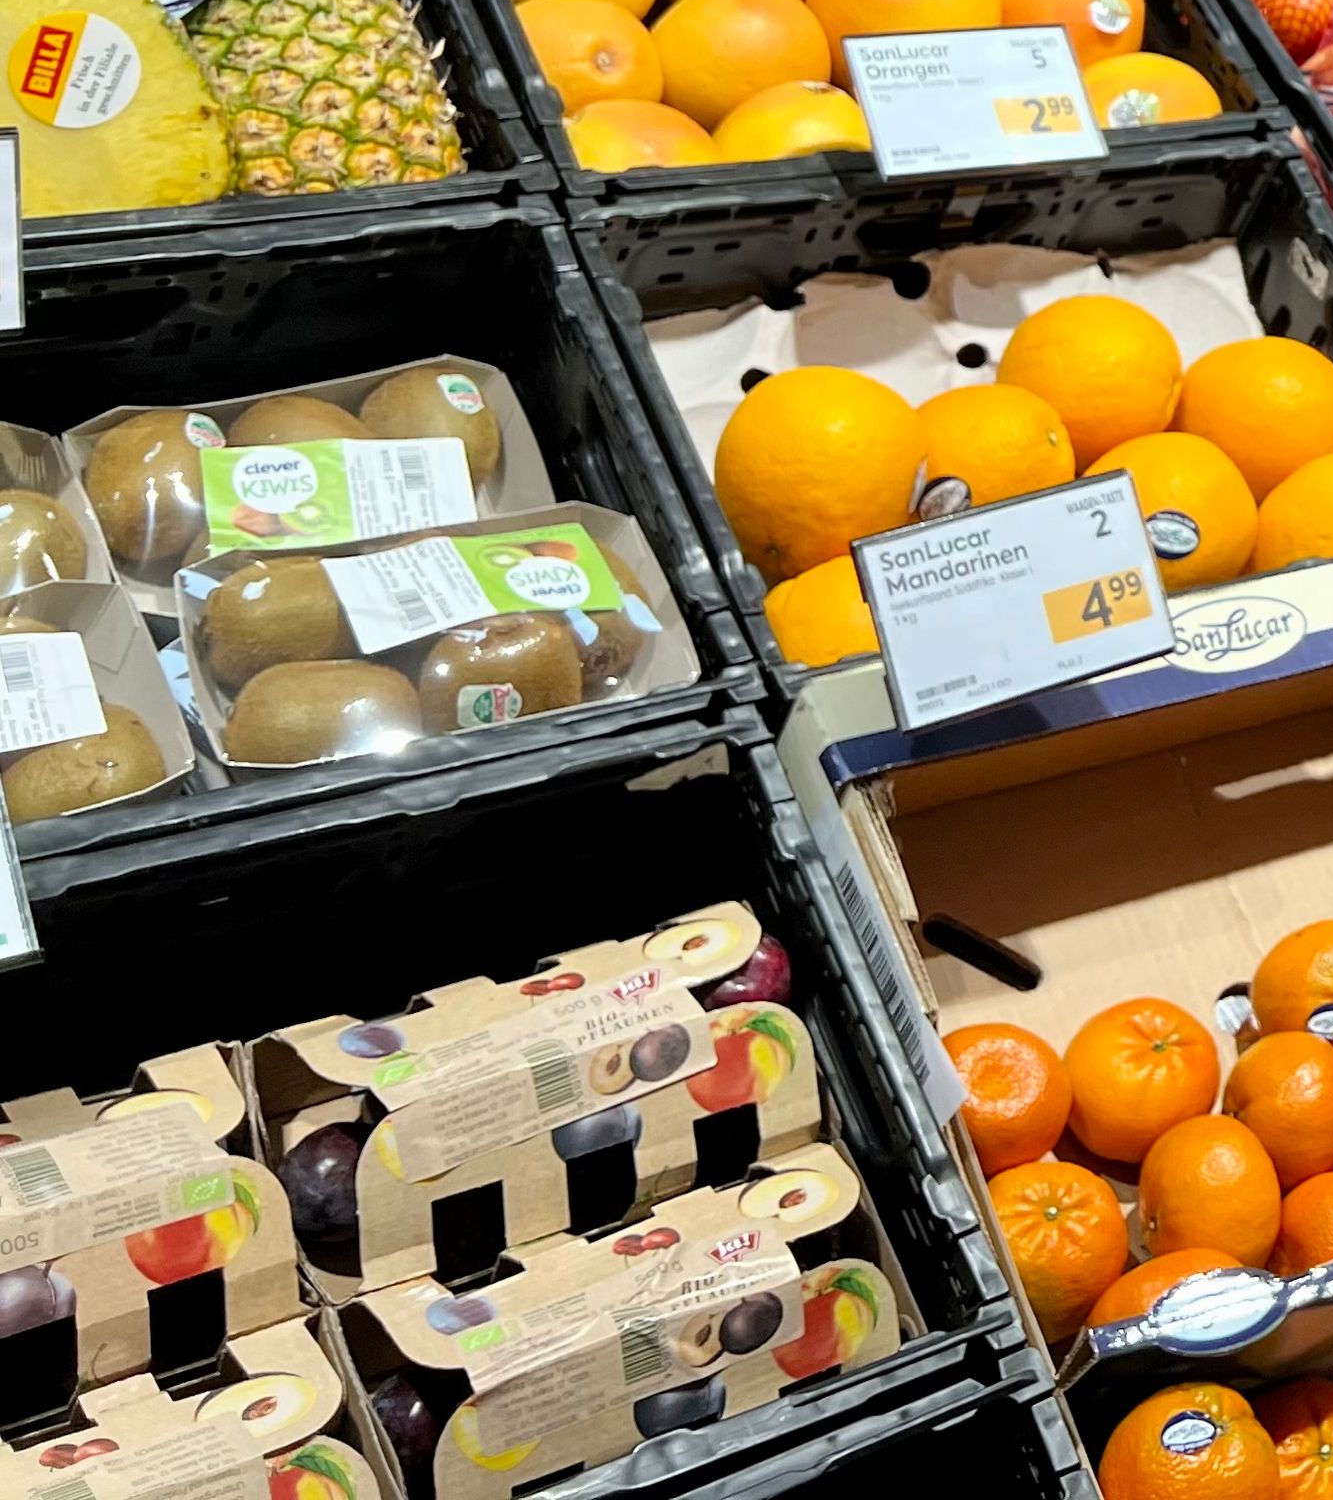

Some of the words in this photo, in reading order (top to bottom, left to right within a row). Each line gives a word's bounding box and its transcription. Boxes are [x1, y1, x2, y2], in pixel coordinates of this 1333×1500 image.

[28, 33, 68, 95] BILLA
[858, 43, 950, 63] SanLucar
[865, 63, 951, 81] Orangen
[244, 459, 301, 475] clever
[240, 474, 315, 499] KIWIS
[1090, 508, 1112, 538] 2
[879, 527, 992, 573] SanLucar
[885, 543, 1030, 596] Mandarinen
[576, 1002, 675, 1046] PFLAUMEN
